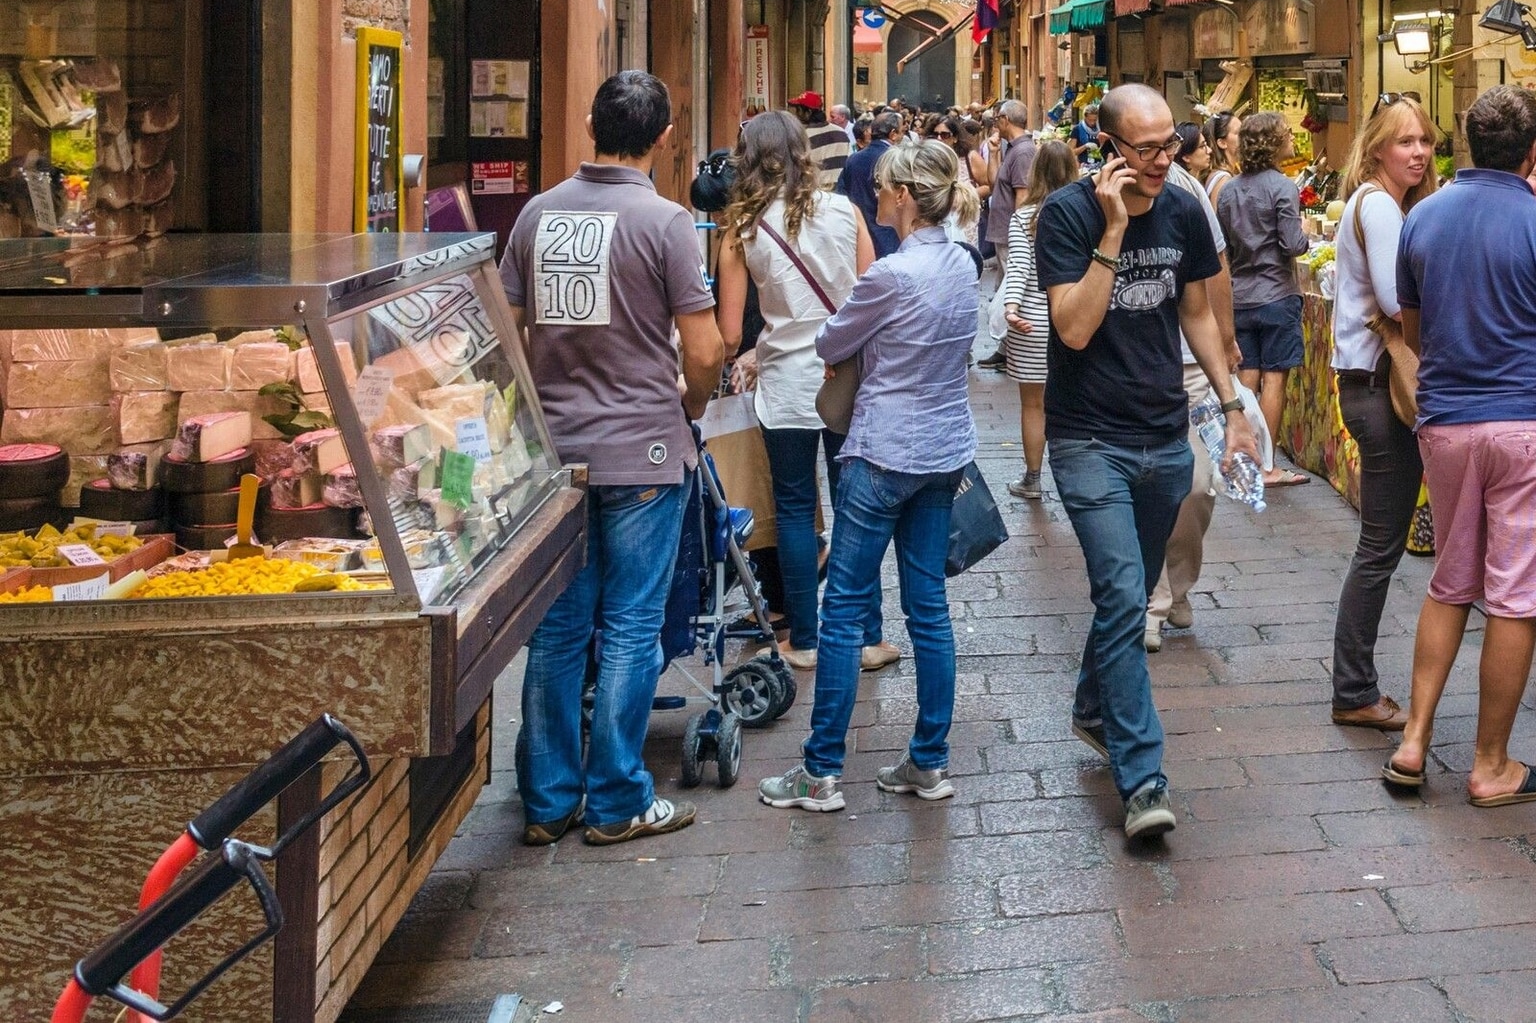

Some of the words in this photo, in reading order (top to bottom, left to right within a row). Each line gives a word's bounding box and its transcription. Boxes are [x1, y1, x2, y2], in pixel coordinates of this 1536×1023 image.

[755, 40, 763, 95] FRESCHE
[542, 216, 604, 264] 20
[544, 273, 596, 321] 10
